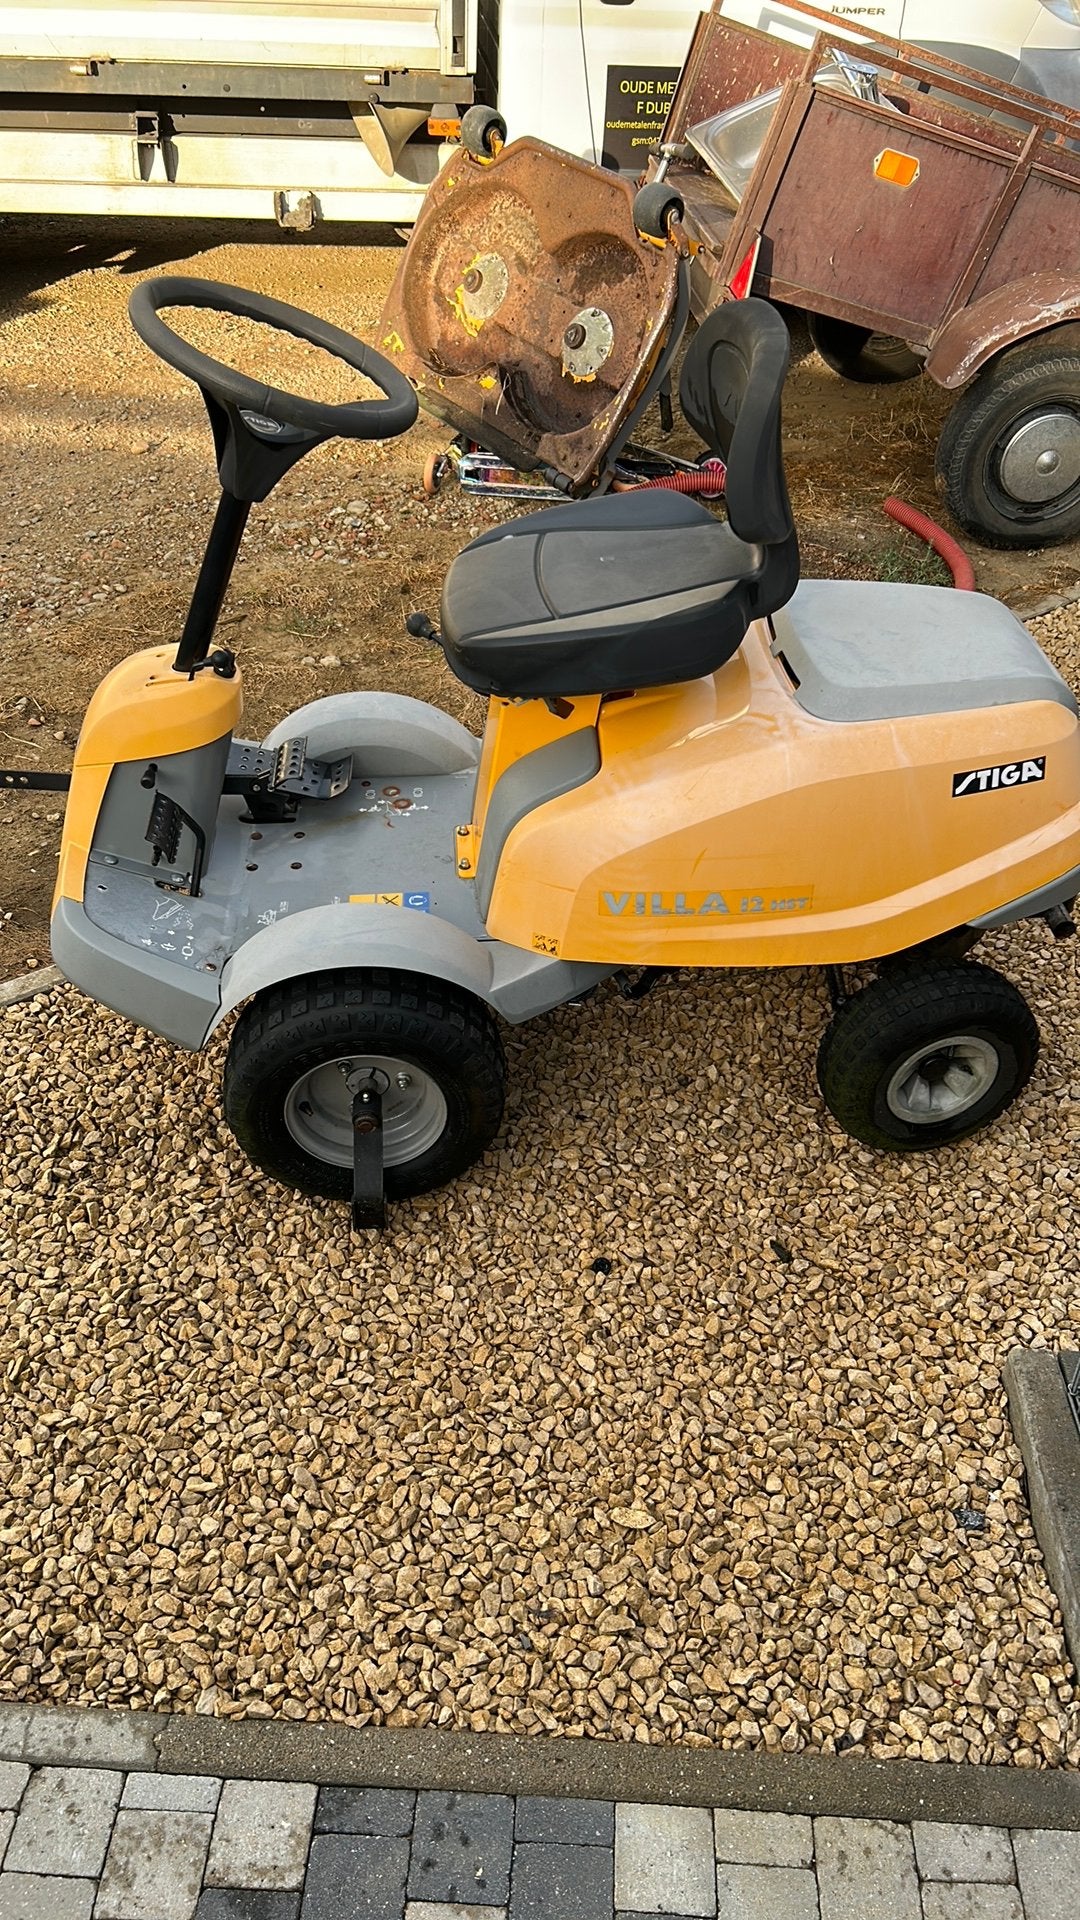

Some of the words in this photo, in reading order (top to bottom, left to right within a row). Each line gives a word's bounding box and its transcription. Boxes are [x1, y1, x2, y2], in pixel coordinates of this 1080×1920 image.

[831, 5, 886, 15] JUMPER
[620, 80, 654, 94] OUDE
[636, 101, 645, 114] F
[954, 760, 1043, 795] STIGA
[603, 891, 730, 916] VILLA
[740, 896, 765, 912] 12
[770, 897, 809, 911] HST
